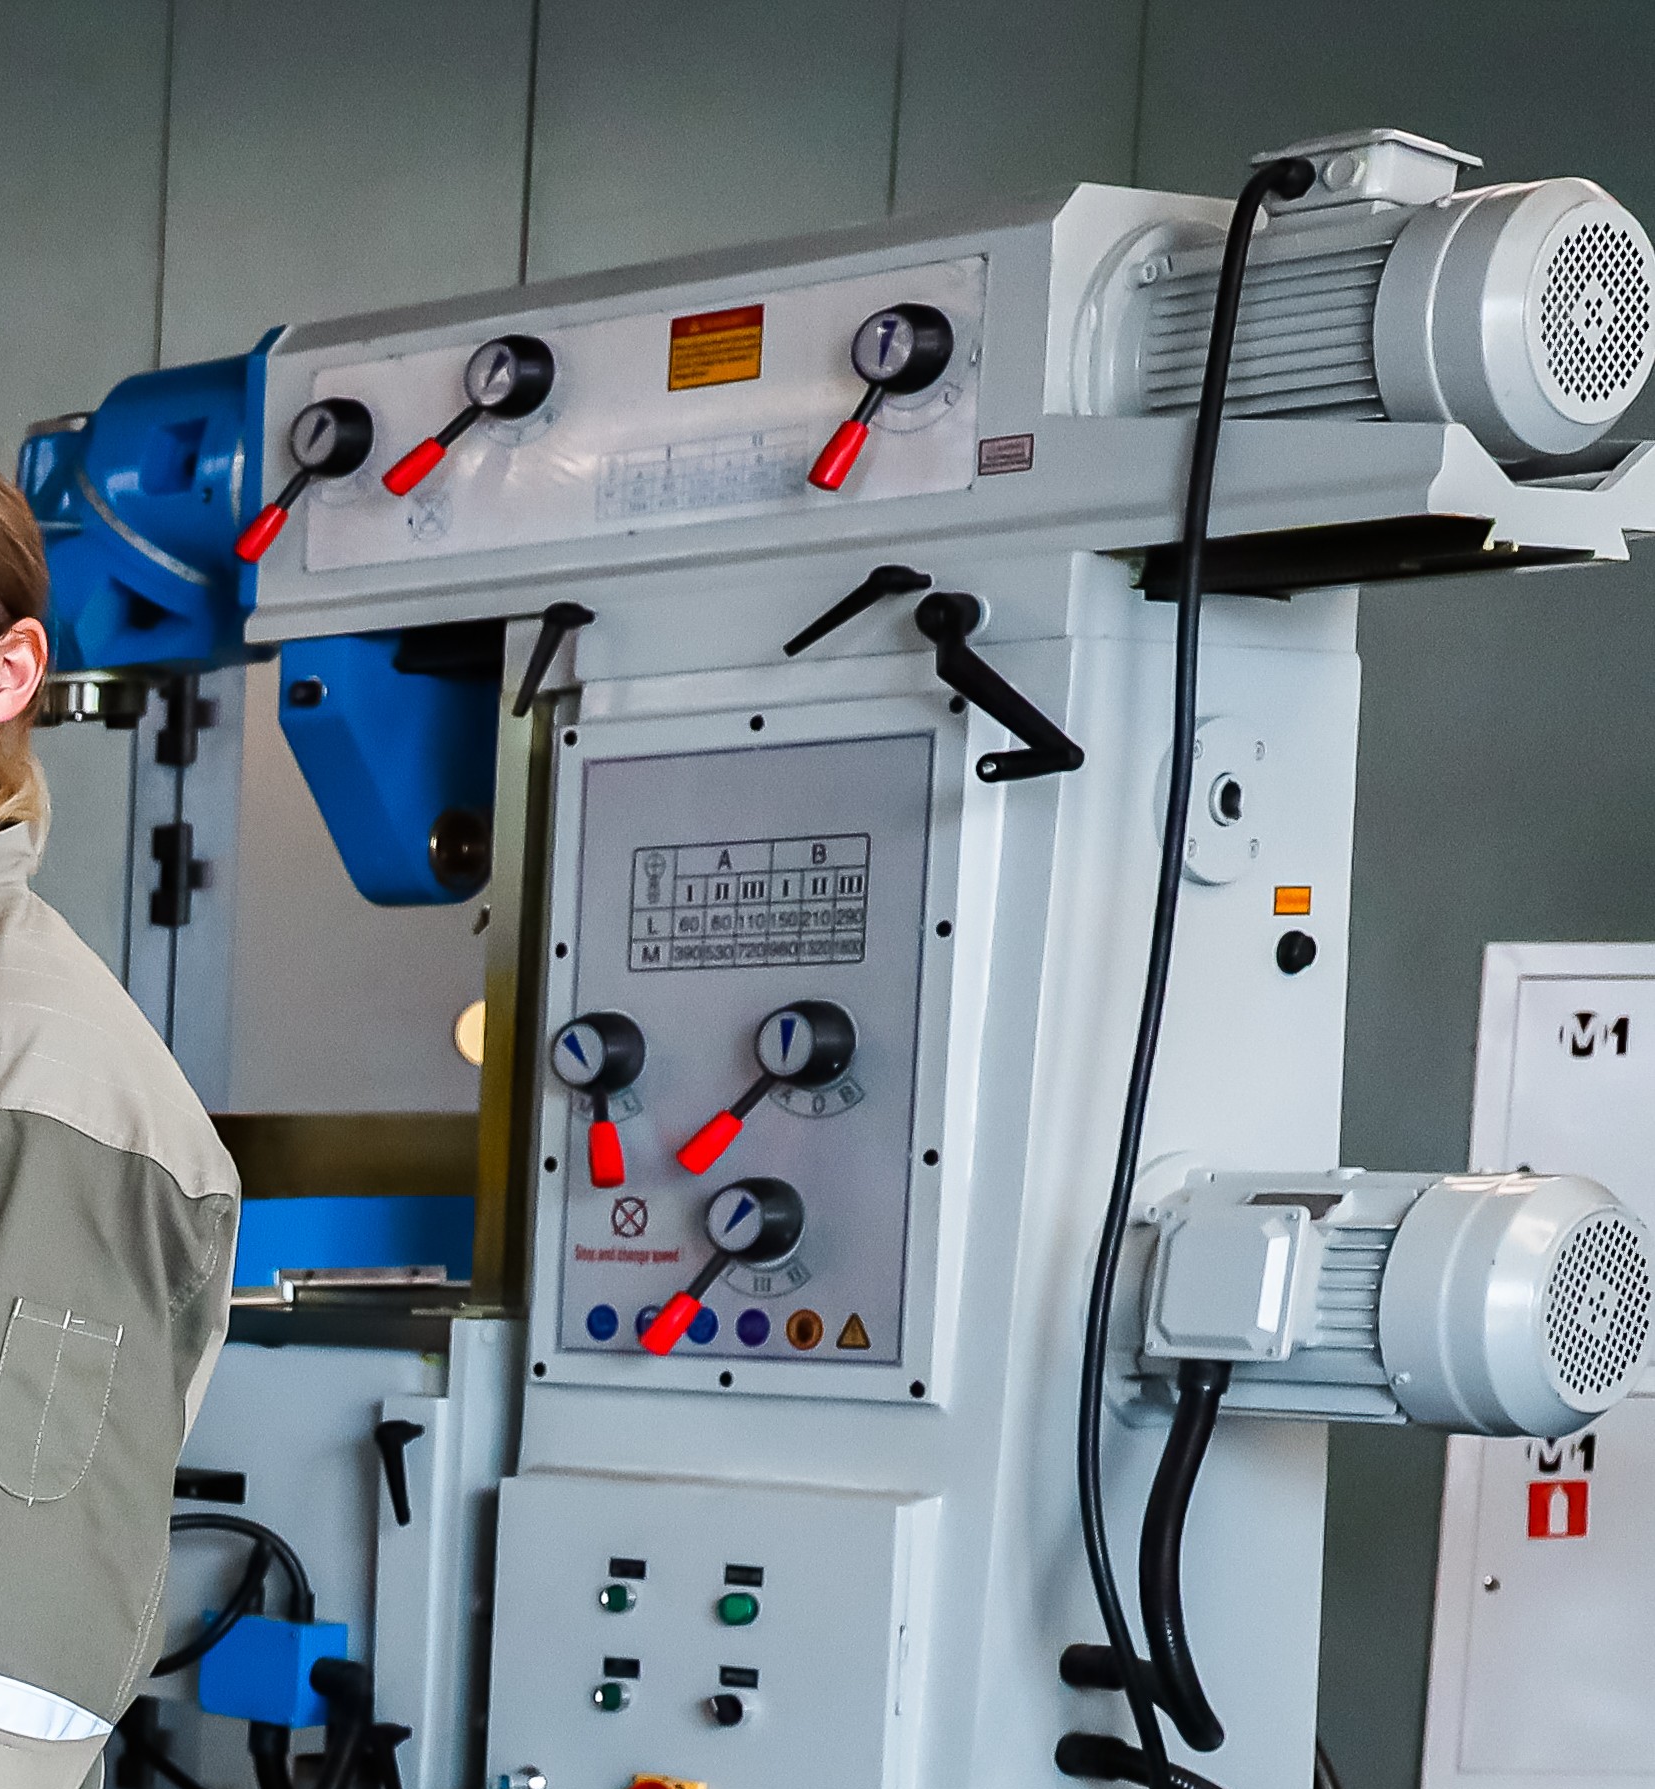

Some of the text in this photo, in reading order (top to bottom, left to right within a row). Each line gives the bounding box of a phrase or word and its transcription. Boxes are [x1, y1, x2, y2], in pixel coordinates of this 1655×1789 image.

[717, 843, 827, 871] A B
[715, 883, 730, 900] II
[742, 880, 765, 898] III
[811, 877, 827, 895] II
[647, 915, 659, 934] L
[641, 944, 661, 964] M
